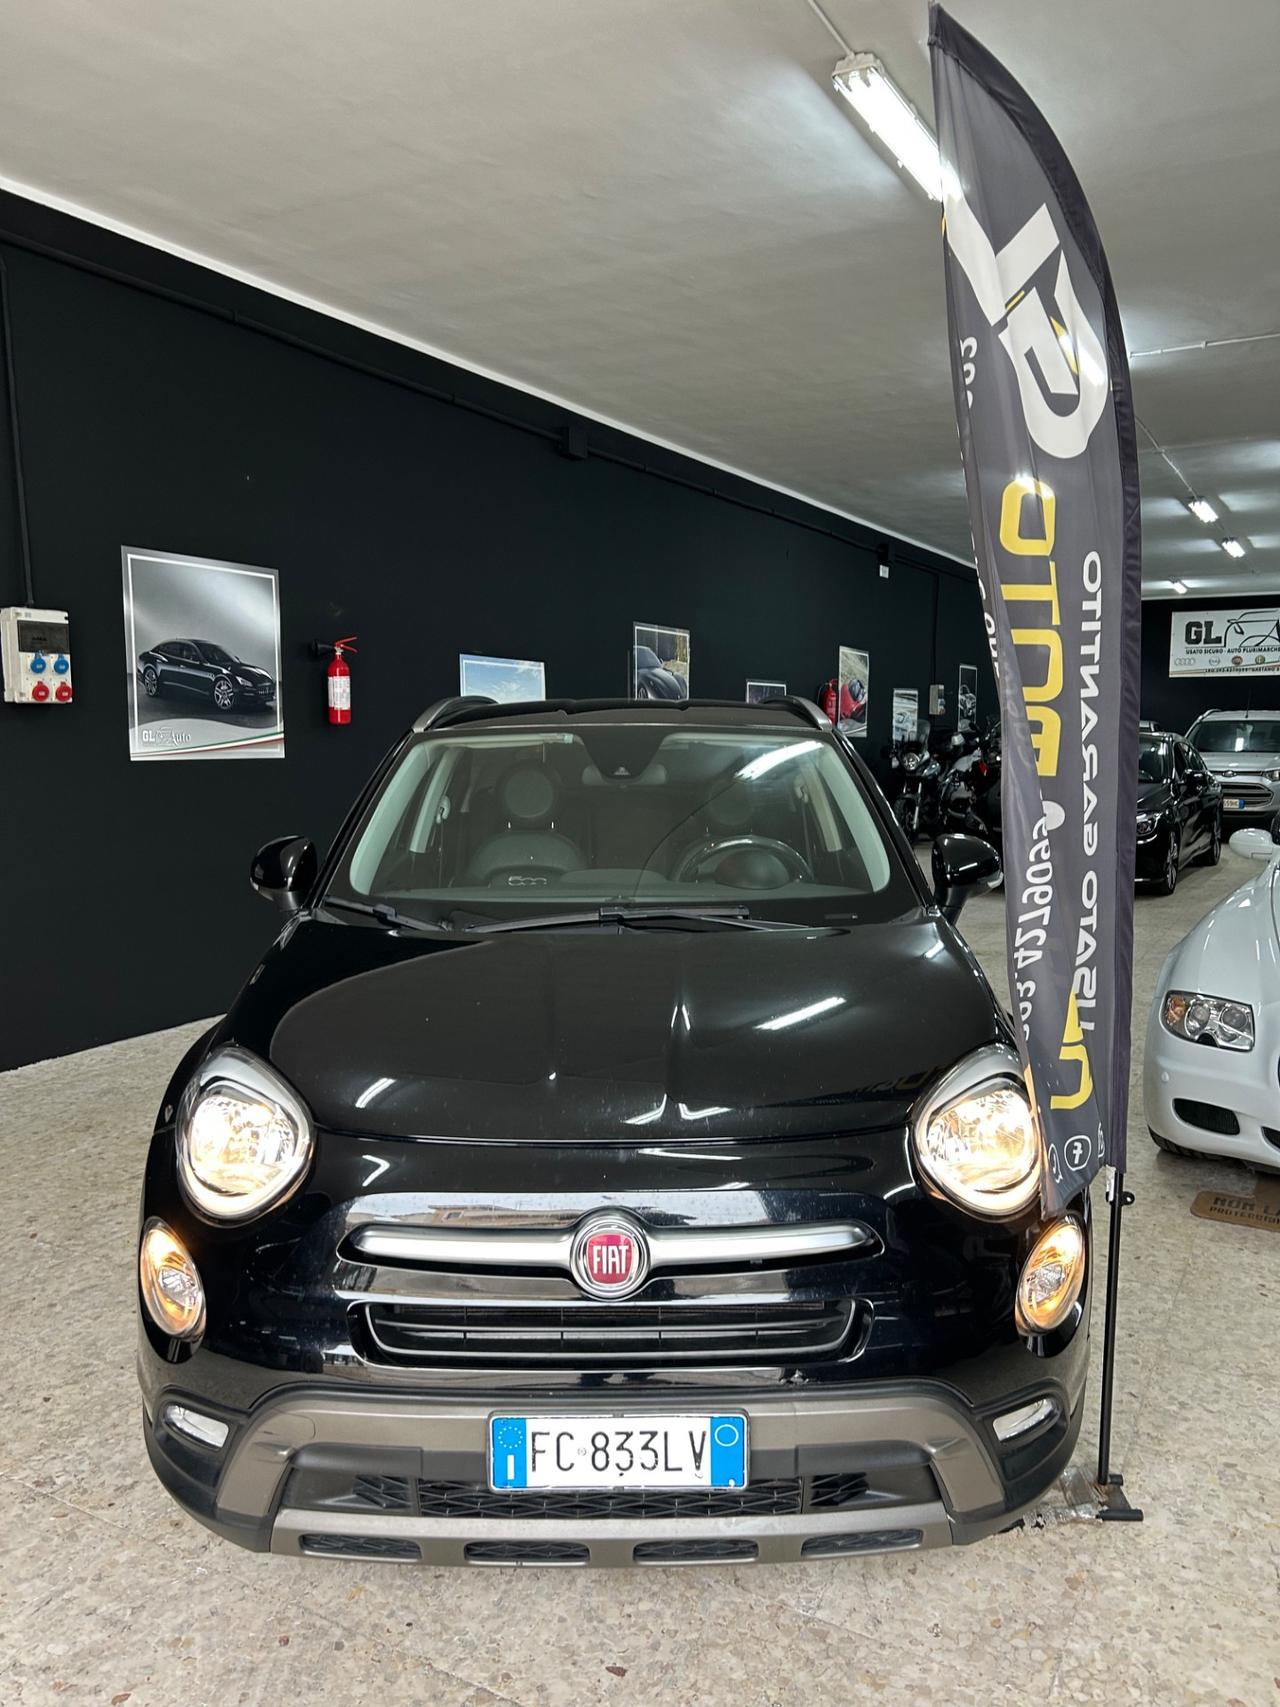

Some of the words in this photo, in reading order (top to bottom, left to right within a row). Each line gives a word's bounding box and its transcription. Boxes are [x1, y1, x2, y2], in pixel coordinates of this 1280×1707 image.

[1185, 621, 1222, 645] GL
[142, 730, 156, 742] GL
[592, 1245, 629, 1274] FIAT
[531, 1431, 575, 1472] FC
[591, 1431, 706, 1472] 833LV
